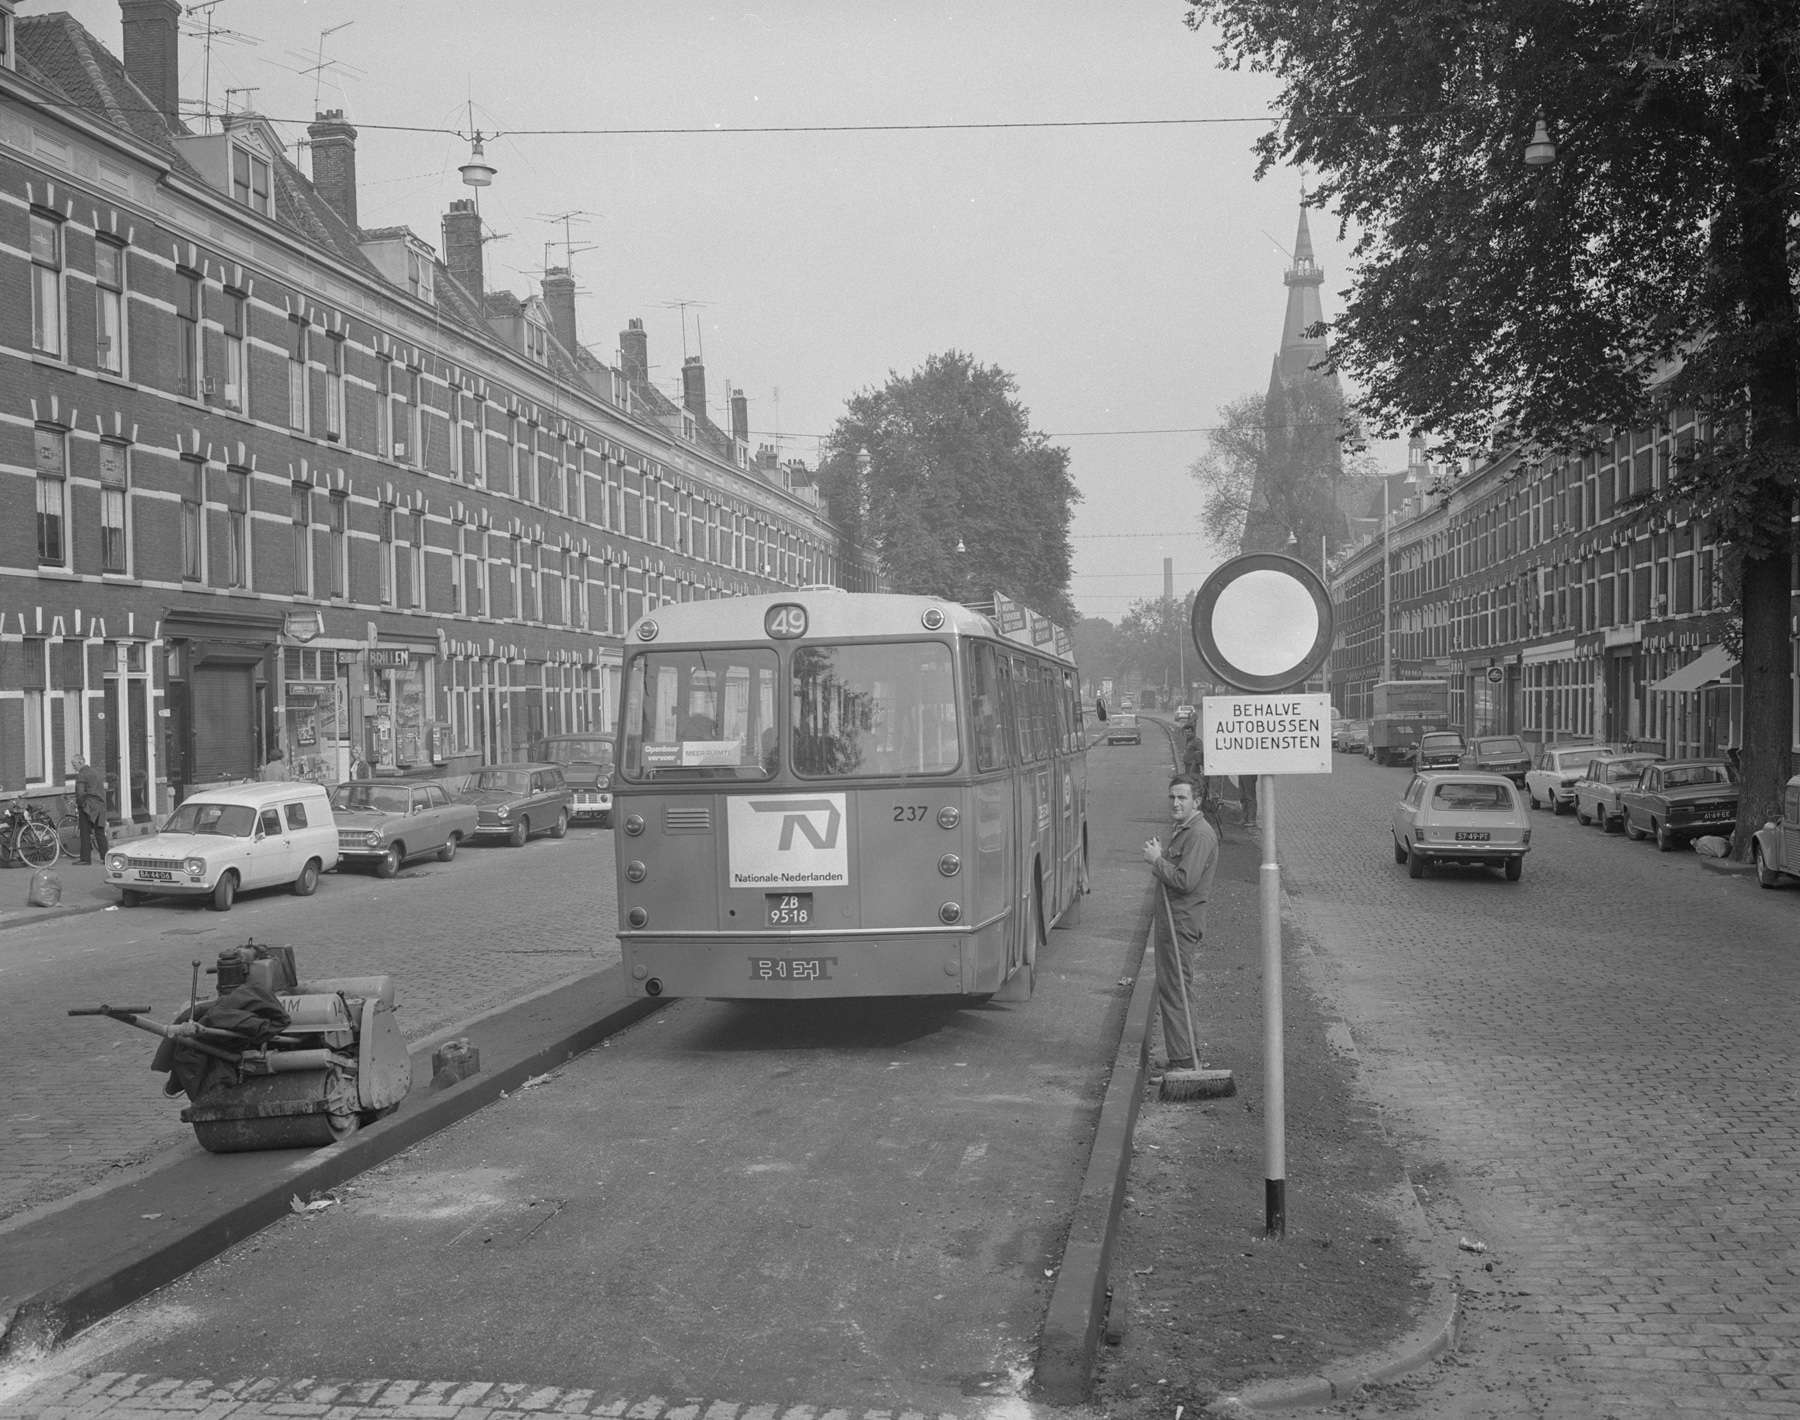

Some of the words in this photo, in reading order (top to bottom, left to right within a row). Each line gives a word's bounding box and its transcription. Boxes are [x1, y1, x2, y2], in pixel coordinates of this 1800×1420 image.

[771, 609, 806, 634] 49
[369, 650, 409, 666] BRILLEN
[1233, 702, 1301, 717] BEHALVE
[1216, 719, 1319, 734] AUTOBUSSEN
[644, 745, 680, 754] Openbaar
[893, 806, 928, 822] 237
[734, 872, 843, 882] Nationale-Nederlanden
[780, 896, 799, 909] ZB
[770, 910, 808, 923] 95-18
